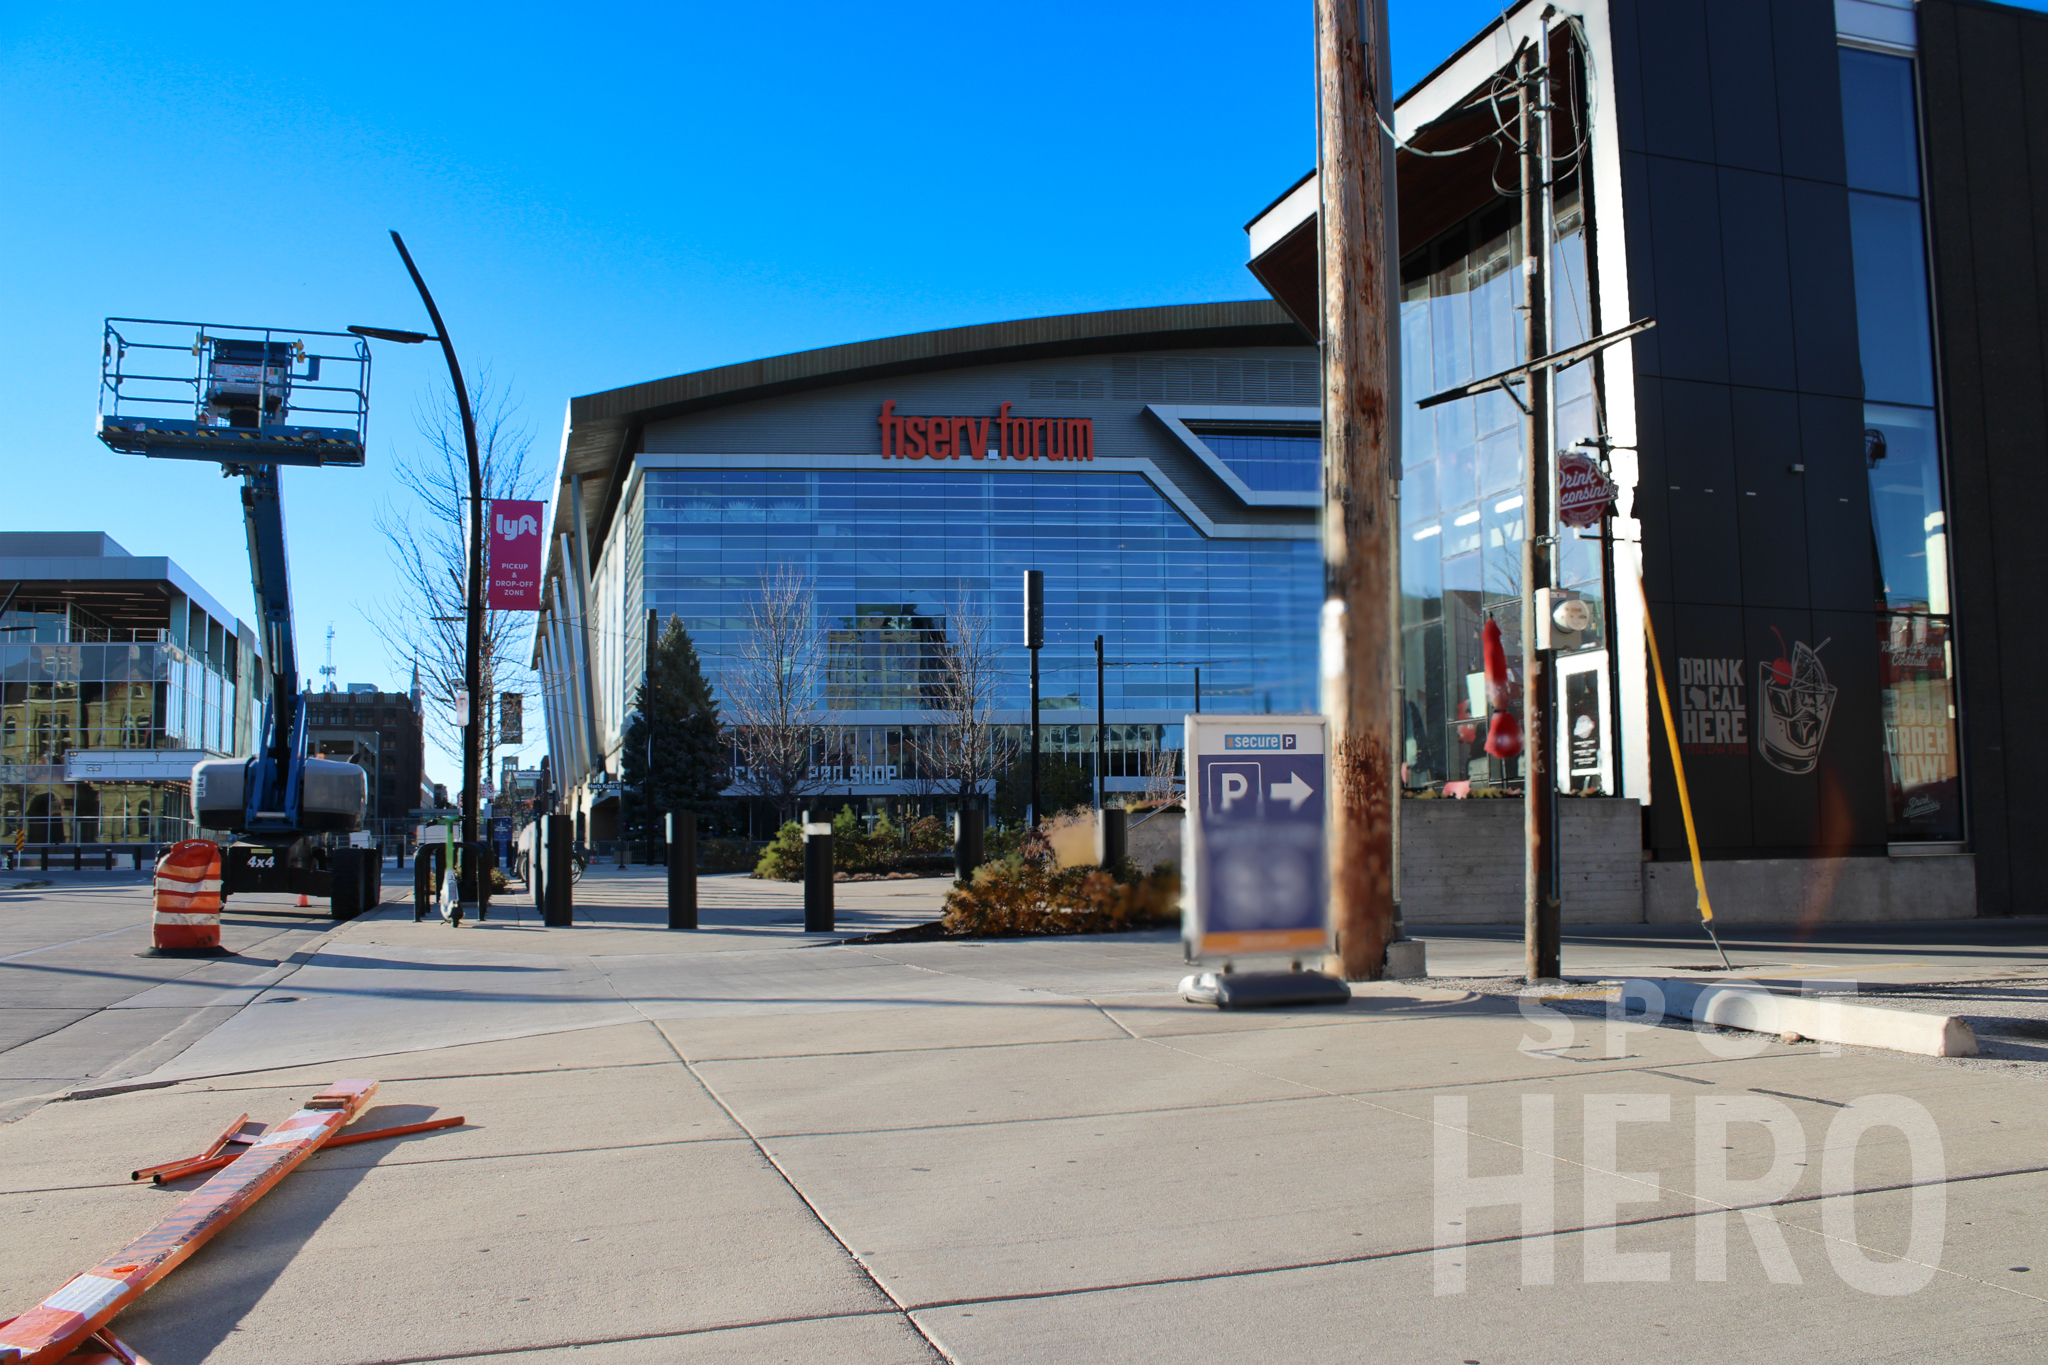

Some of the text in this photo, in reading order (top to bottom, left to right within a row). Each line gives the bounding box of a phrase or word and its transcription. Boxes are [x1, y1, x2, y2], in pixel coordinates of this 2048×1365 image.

[996, 401, 1094, 461] forum
[496, 514, 538, 541] lyft
[495, 580, 534, 588] DROP-OFF
[1679, 658, 1745, 686] DRINK
[1891, 655, 1929, 667] Cocktails
[1682, 710, 1748, 743] HERE
[1886, 726, 1949, 754] ORDER
[1235, 736, 1279, 748] secure
[1683, 744, 1706, 755] THE
[1729, 743, 1749, 755] PUB
[808, 765, 843, 785] PRO
[849, 765, 897, 785] SHOP
[1890, 755, 1948, 784] NOW!
[1221, 773, 1248, 811] P
[246, 855, 275, 868] 4x4
